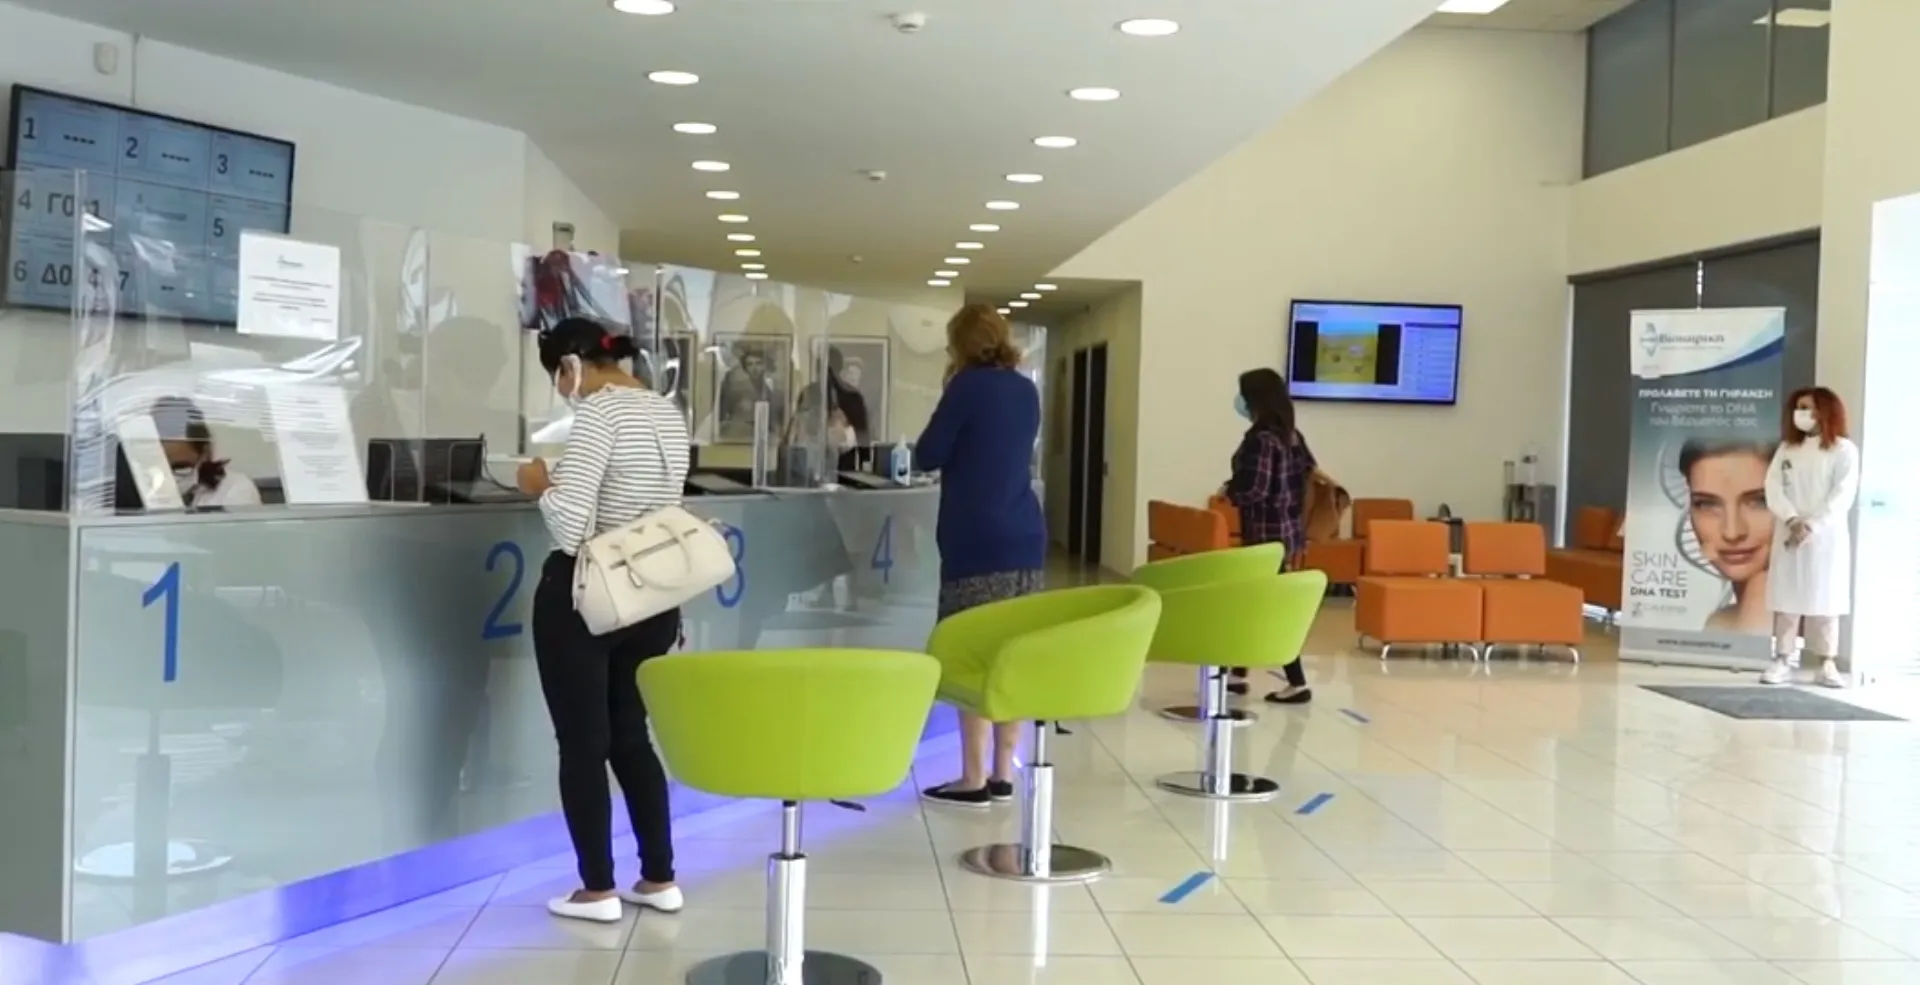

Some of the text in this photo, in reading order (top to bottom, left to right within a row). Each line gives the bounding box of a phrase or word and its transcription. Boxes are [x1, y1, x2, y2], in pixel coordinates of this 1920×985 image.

[22, 116, 37, 139] 1
[125, 136, 139, 159] 2
[216, 154, 229, 175] 3
[17, 188, 32, 211] 4
[213, 217, 225, 238] 5
[13, 259, 28, 282] 6
[118, 269, 130, 291] 7
[1638, 387, 1774, 400] ΠΡΟΛΑΒΕΤΕ ΤΗ ΓΗΡΑΝΣΗ
[1725, 402, 1757, 415] DNA
[871, 514, 896, 585] 4
[1632, 550, 1678, 569] SKIN
[715, 524, 746, 608] 3
[1631, 569, 1688, 588] CARE
[482, 540, 525, 640] 2
[1629, 585, 1687, 600] DNA TEST
[142, 561, 181, 683] 1
